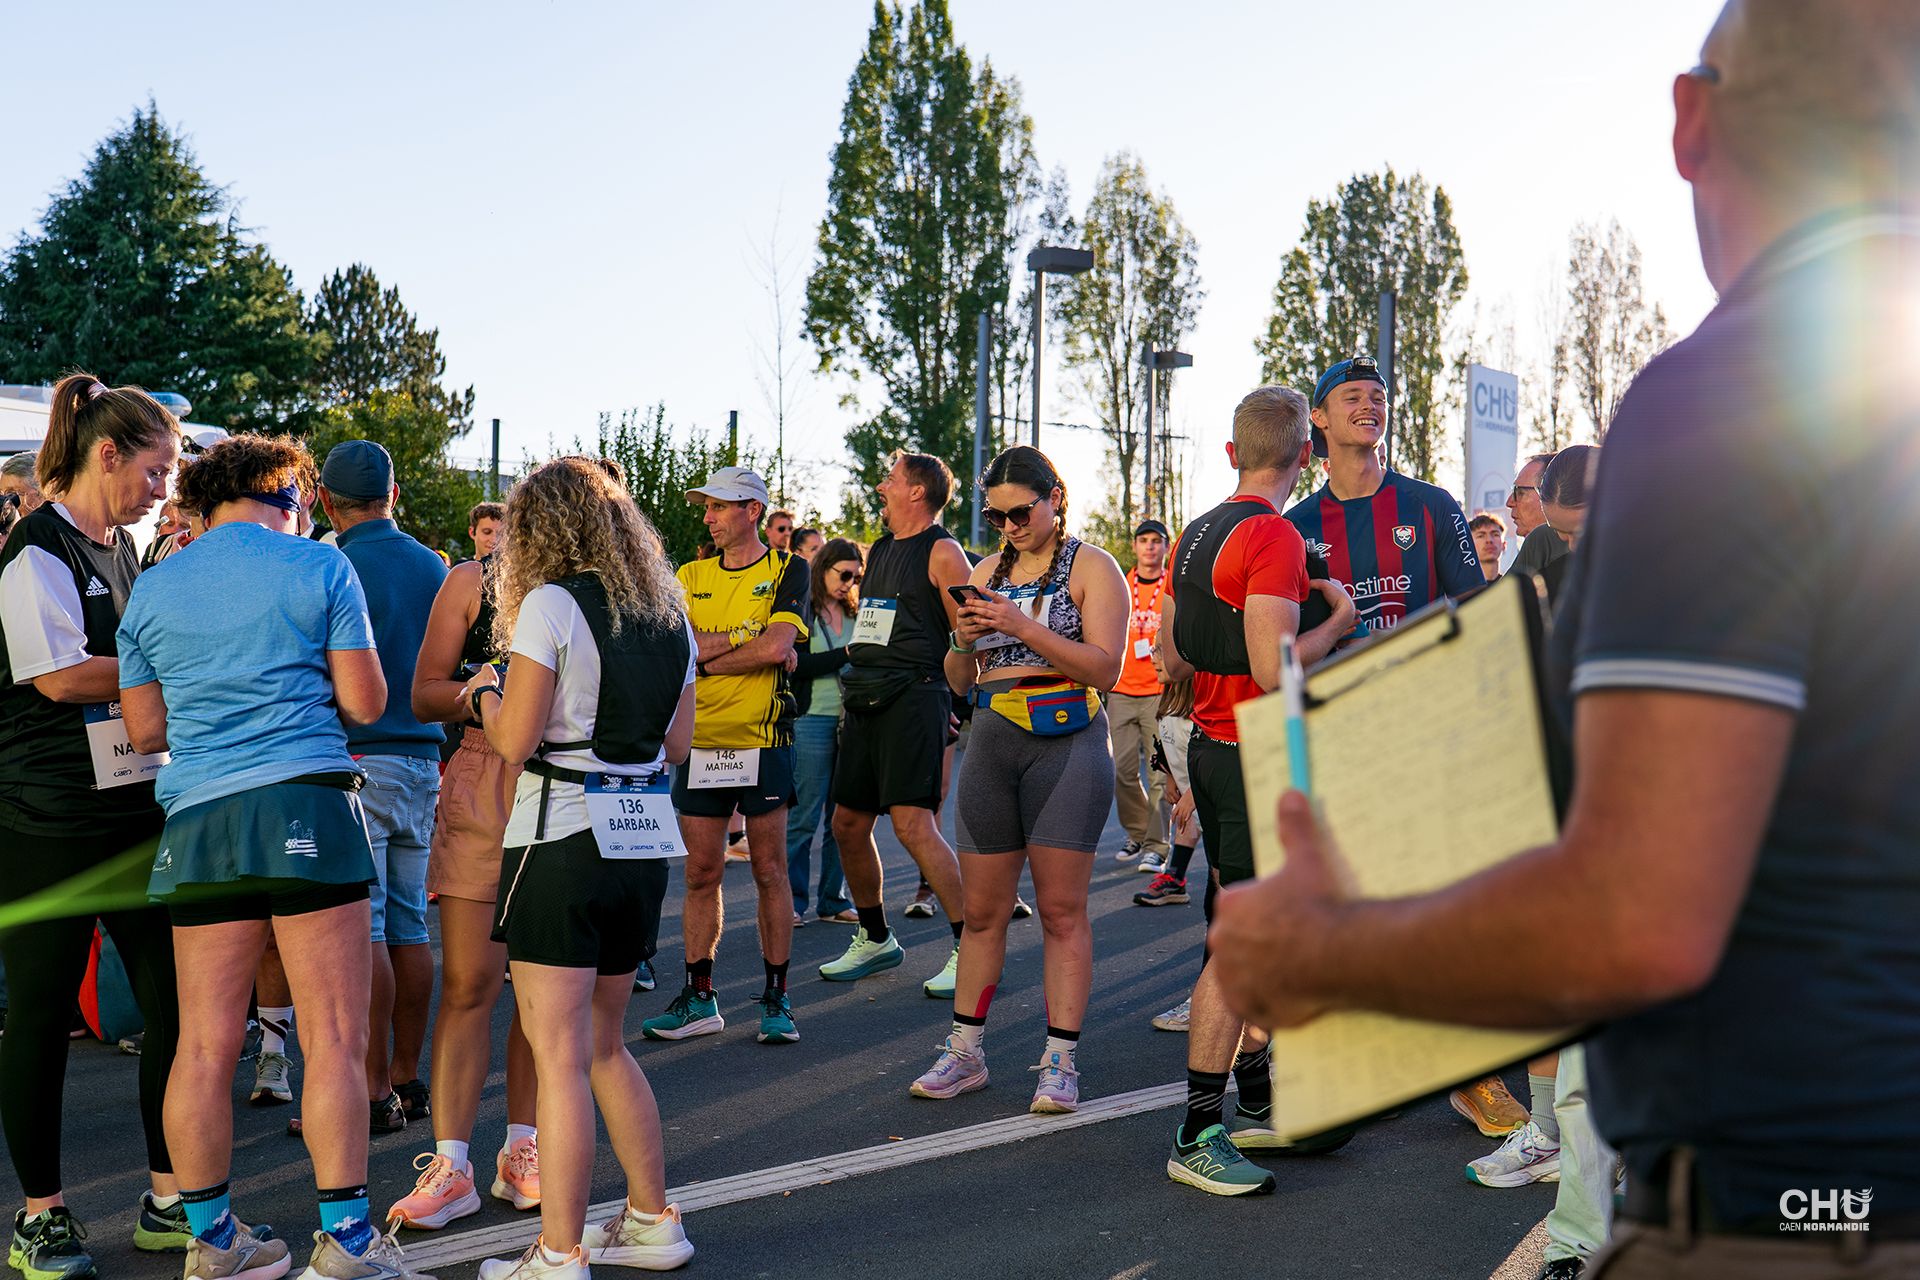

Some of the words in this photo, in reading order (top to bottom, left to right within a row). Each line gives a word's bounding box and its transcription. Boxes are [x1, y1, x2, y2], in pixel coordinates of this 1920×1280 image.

[1474, 382, 1516, 422] CHU
[1451, 513, 1476, 567] ALTICAP
[1181, 523, 1210, 575] KIPRUN
[86, 587, 109, 597] adidas
[1343, 574, 1411, 598] ostime
[113, 742, 136, 757] NA
[715, 749, 736, 761] 146
[704, 761, 744, 772] MATHIAS
[618, 798, 645, 814] 136
[608, 818, 661, 831] BARBARA
